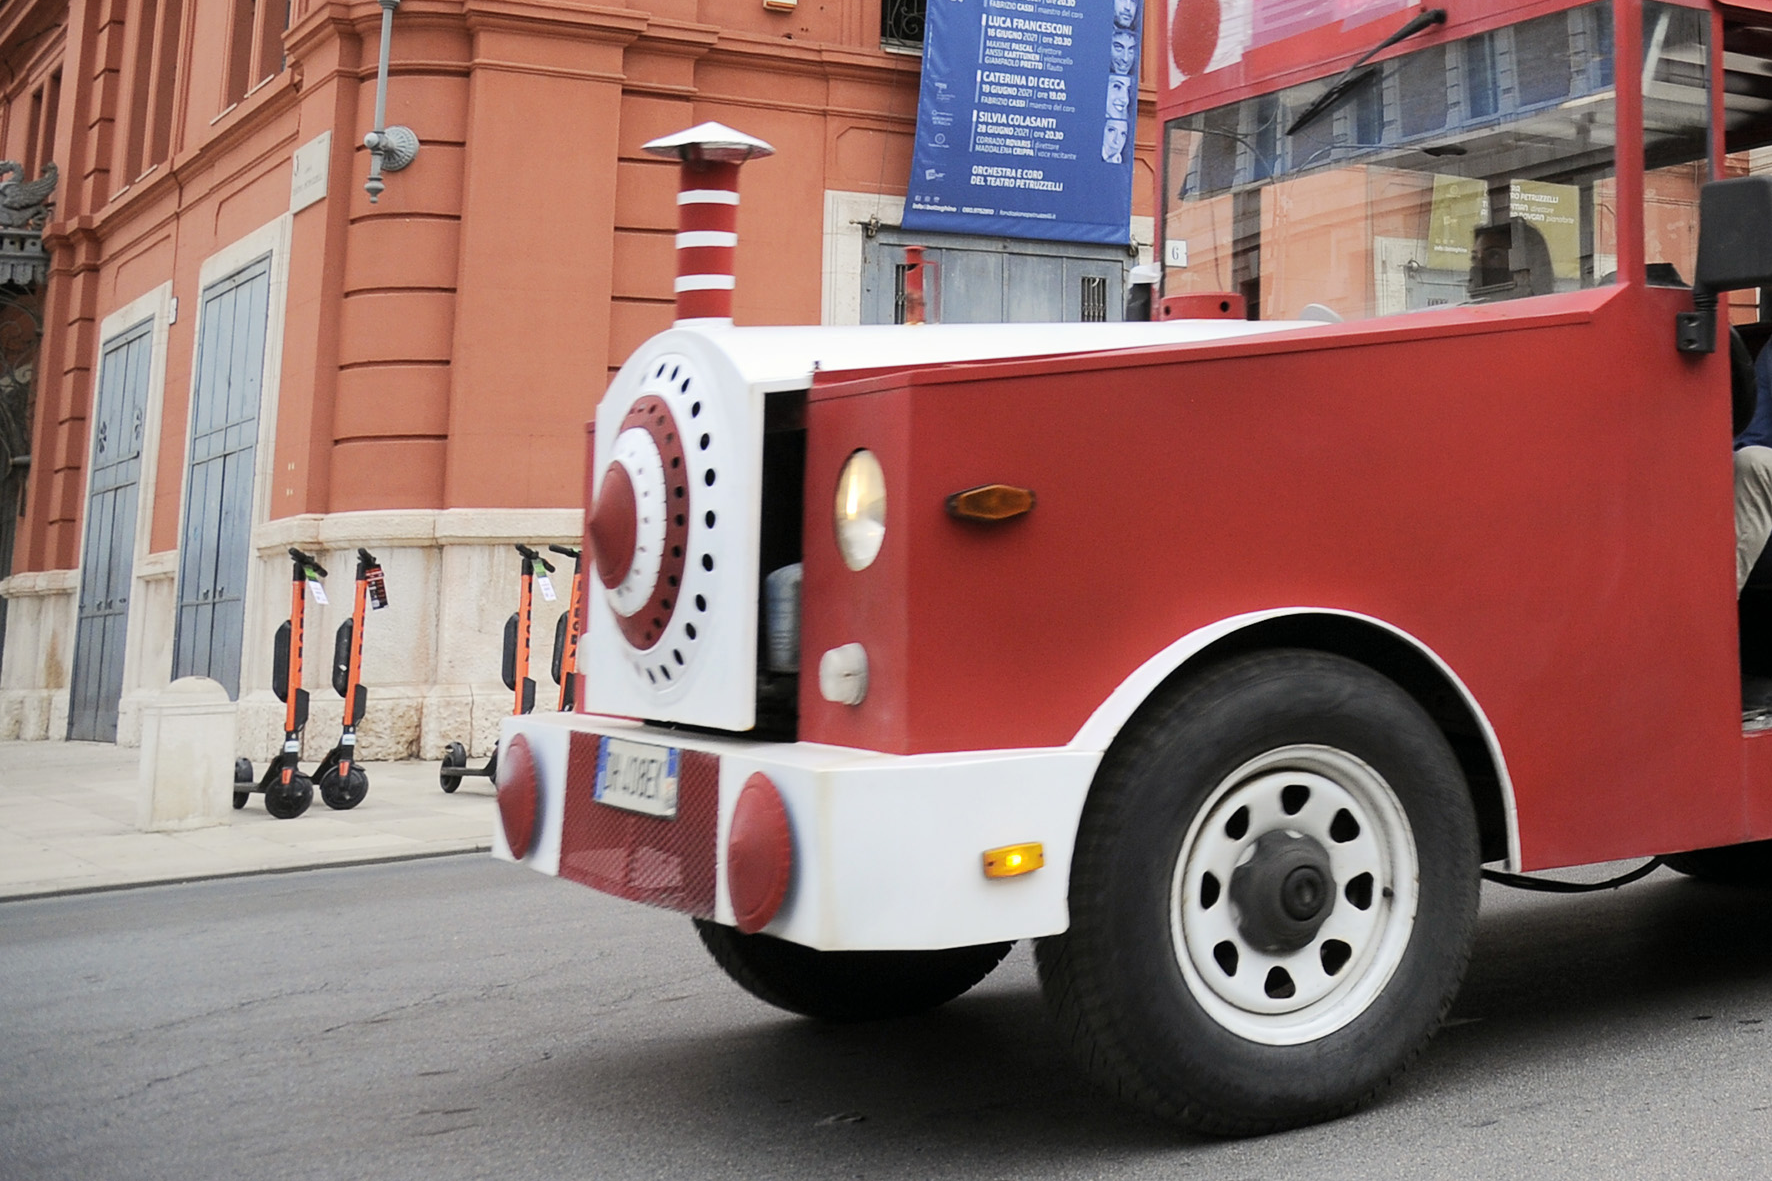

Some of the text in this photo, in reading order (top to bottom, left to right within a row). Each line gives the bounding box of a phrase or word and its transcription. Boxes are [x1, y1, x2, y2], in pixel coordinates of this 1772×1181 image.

[990, 0, 1016, 10] FABRIZIO
[989, 15, 1072, 35] LUCA FRANCESCONI
[996, 29, 1022, 40] GIUGNO
[1023, 33, 1037, 41] 2021
[1054, 37, 1072, 46] 20.30
[983, 71, 1065, 90] CATERINA DI CECCA
[991, 85, 1017, 95] GIUGNO
[1018, 88, 1032, 97] 2021
[981, 96, 1007, 105] FABRIZIO
[979, 112, 1056, 129] SILVIA COLASANTI
[977, 124, 986, 133] 28
[987, 125, 1013, 135] GIUGNO
[1014, 129, 1029, 137] 2021
[1045, 131, 1063, 140] 20.30
[976, 136, 1004, 145] CORRADO
[972, 165, 1043, 180] ORCHESTRA E CORO
[970, 175, 1063, 191] DEL TEATRO PETRUZZELLI
[1521, 193, 1558, 203] PETRUZZELLI
[1172, 246, 1179, 260] 6
